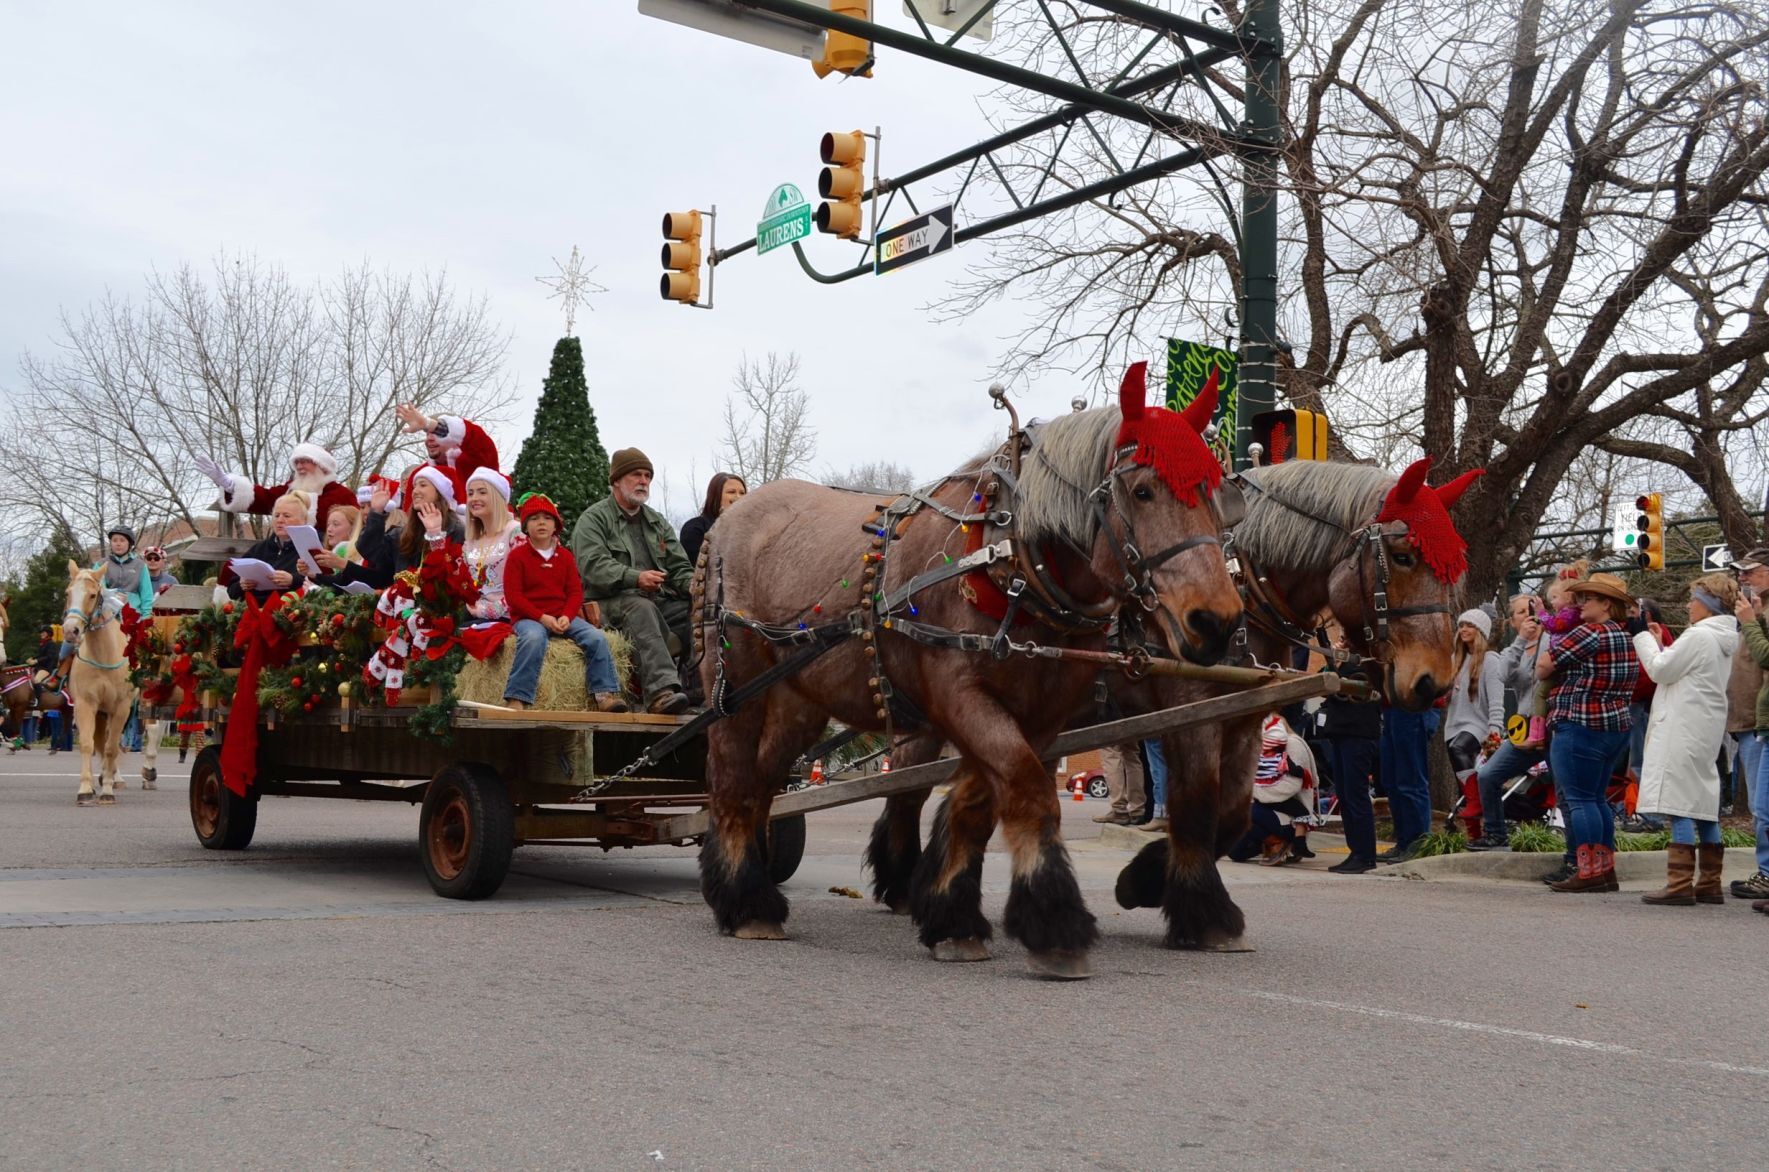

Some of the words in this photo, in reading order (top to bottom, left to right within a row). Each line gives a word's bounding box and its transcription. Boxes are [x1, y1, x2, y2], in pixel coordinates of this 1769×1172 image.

[759, 217, 804, 252] LAURENS
[886, 238, 905, 257] ONE
[907, 228, 928, 249] WAY
